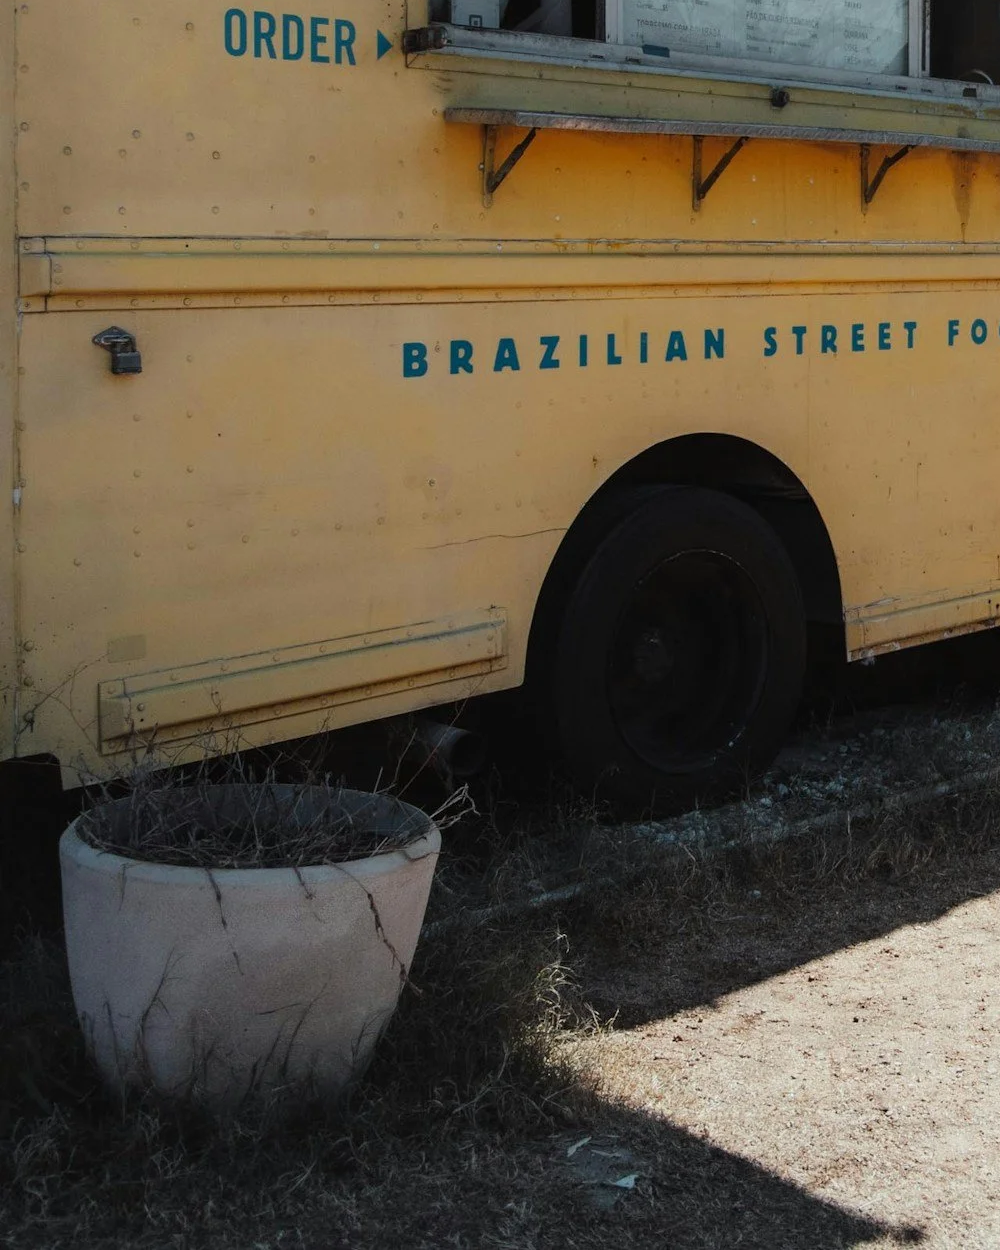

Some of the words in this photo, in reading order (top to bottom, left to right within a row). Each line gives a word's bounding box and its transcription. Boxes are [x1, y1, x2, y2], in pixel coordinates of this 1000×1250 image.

[224, 8, 357, 66] ORDER
[402, 338, 725, 379] BRAZILIAN
[763, 321, 917, 357] STREET
